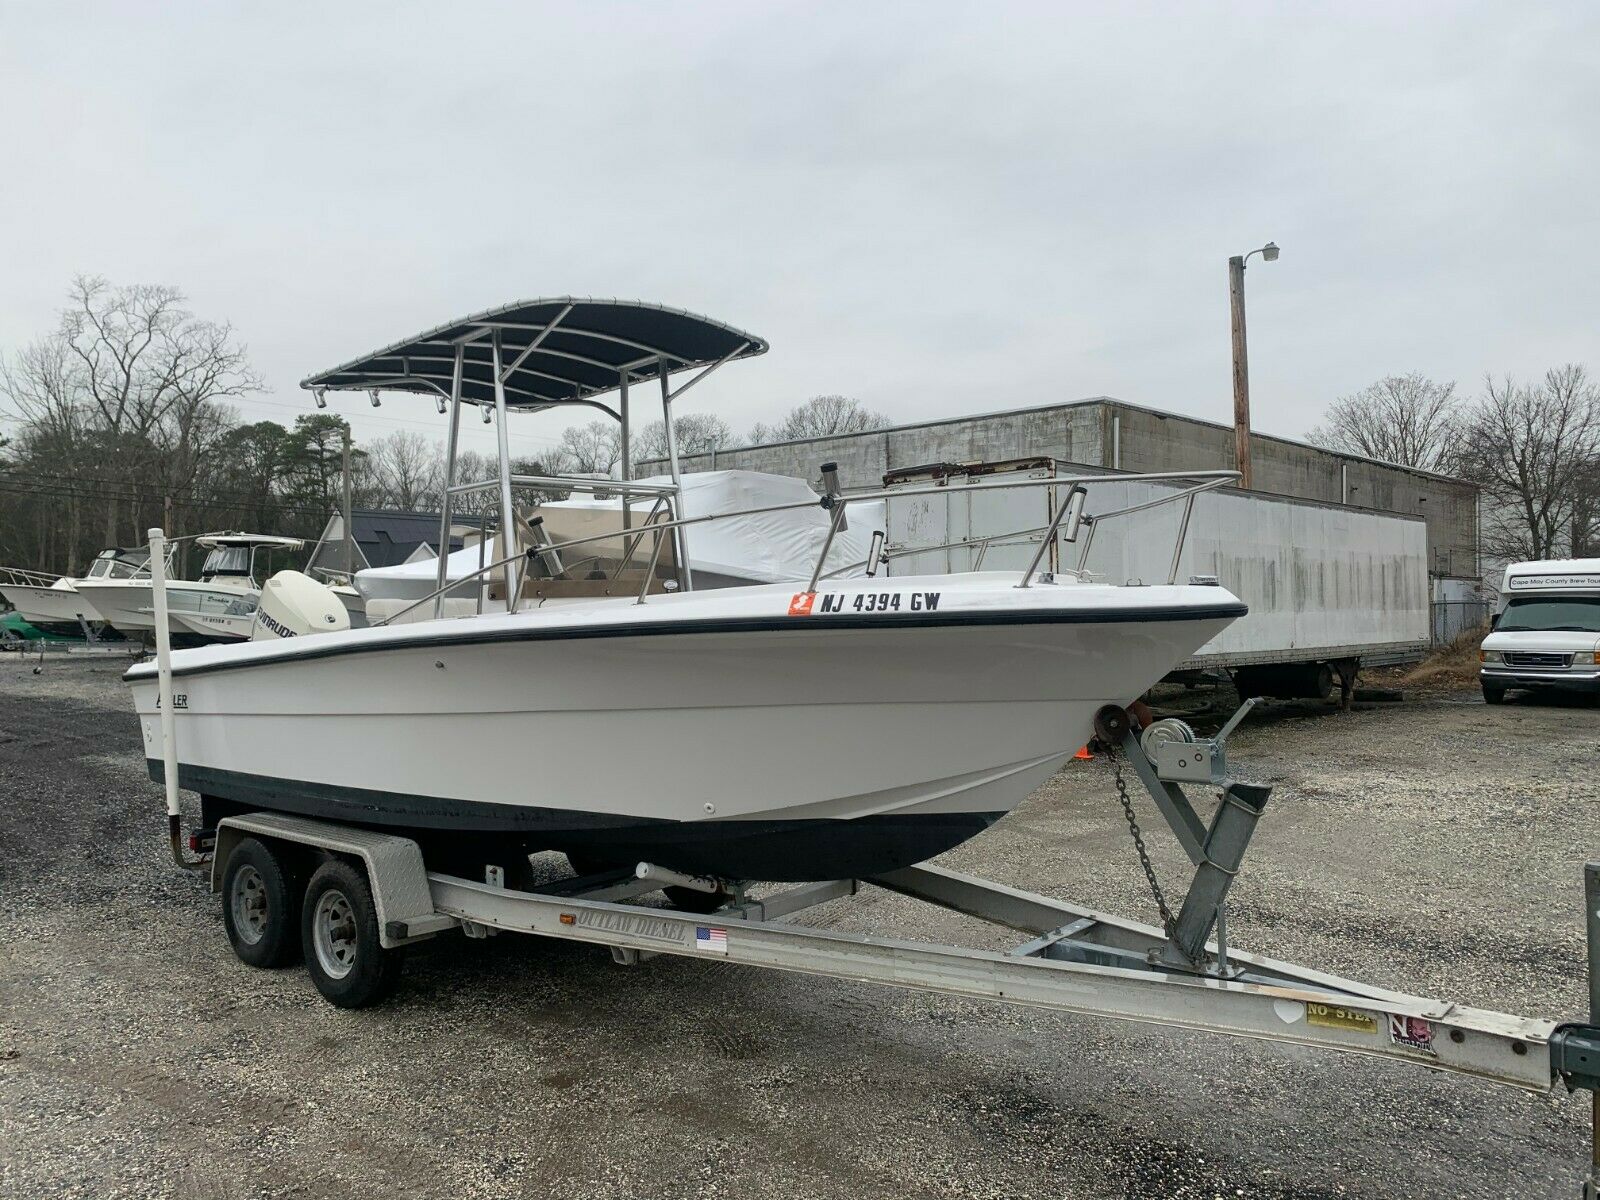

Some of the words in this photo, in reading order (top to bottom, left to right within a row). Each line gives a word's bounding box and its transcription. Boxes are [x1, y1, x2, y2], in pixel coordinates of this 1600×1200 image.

[820, 594, 845, 613] NJ
[853, 593, 901, 612] 4394
[910, 592, 941, 611] GW
[156, 691, 188, 706] ALER
[578, 910, 632, 933] OUTLAW
[634, 919, 685, 941] DIESEL
[1308, 1003, 1328, 1016] NO
